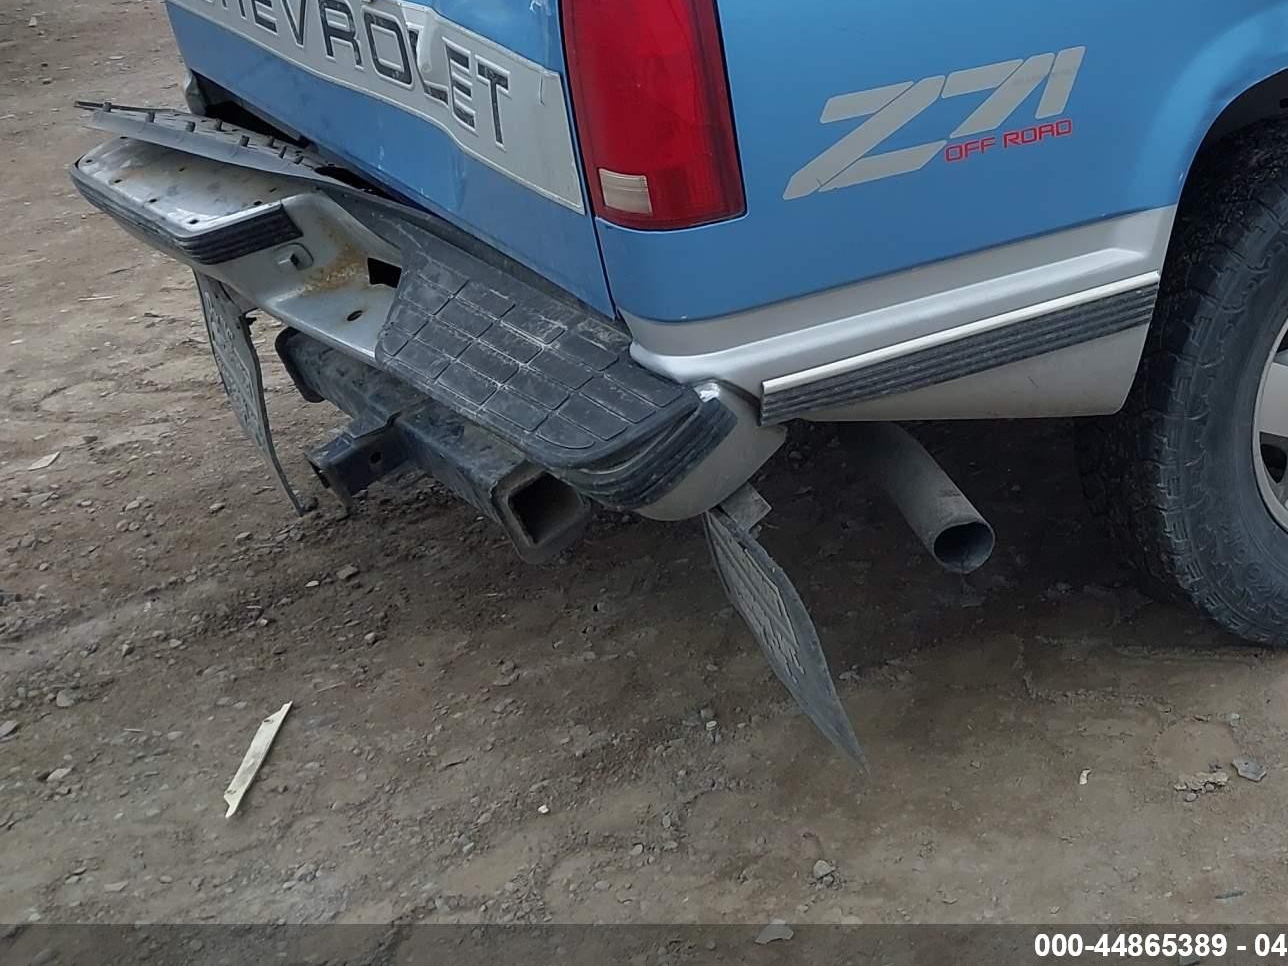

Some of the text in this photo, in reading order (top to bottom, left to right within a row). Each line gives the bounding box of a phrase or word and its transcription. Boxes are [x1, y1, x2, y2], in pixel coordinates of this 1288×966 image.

[783, 45, 1086, 201] Z71
[944, 119, 1073, 162] OFF ROAD
